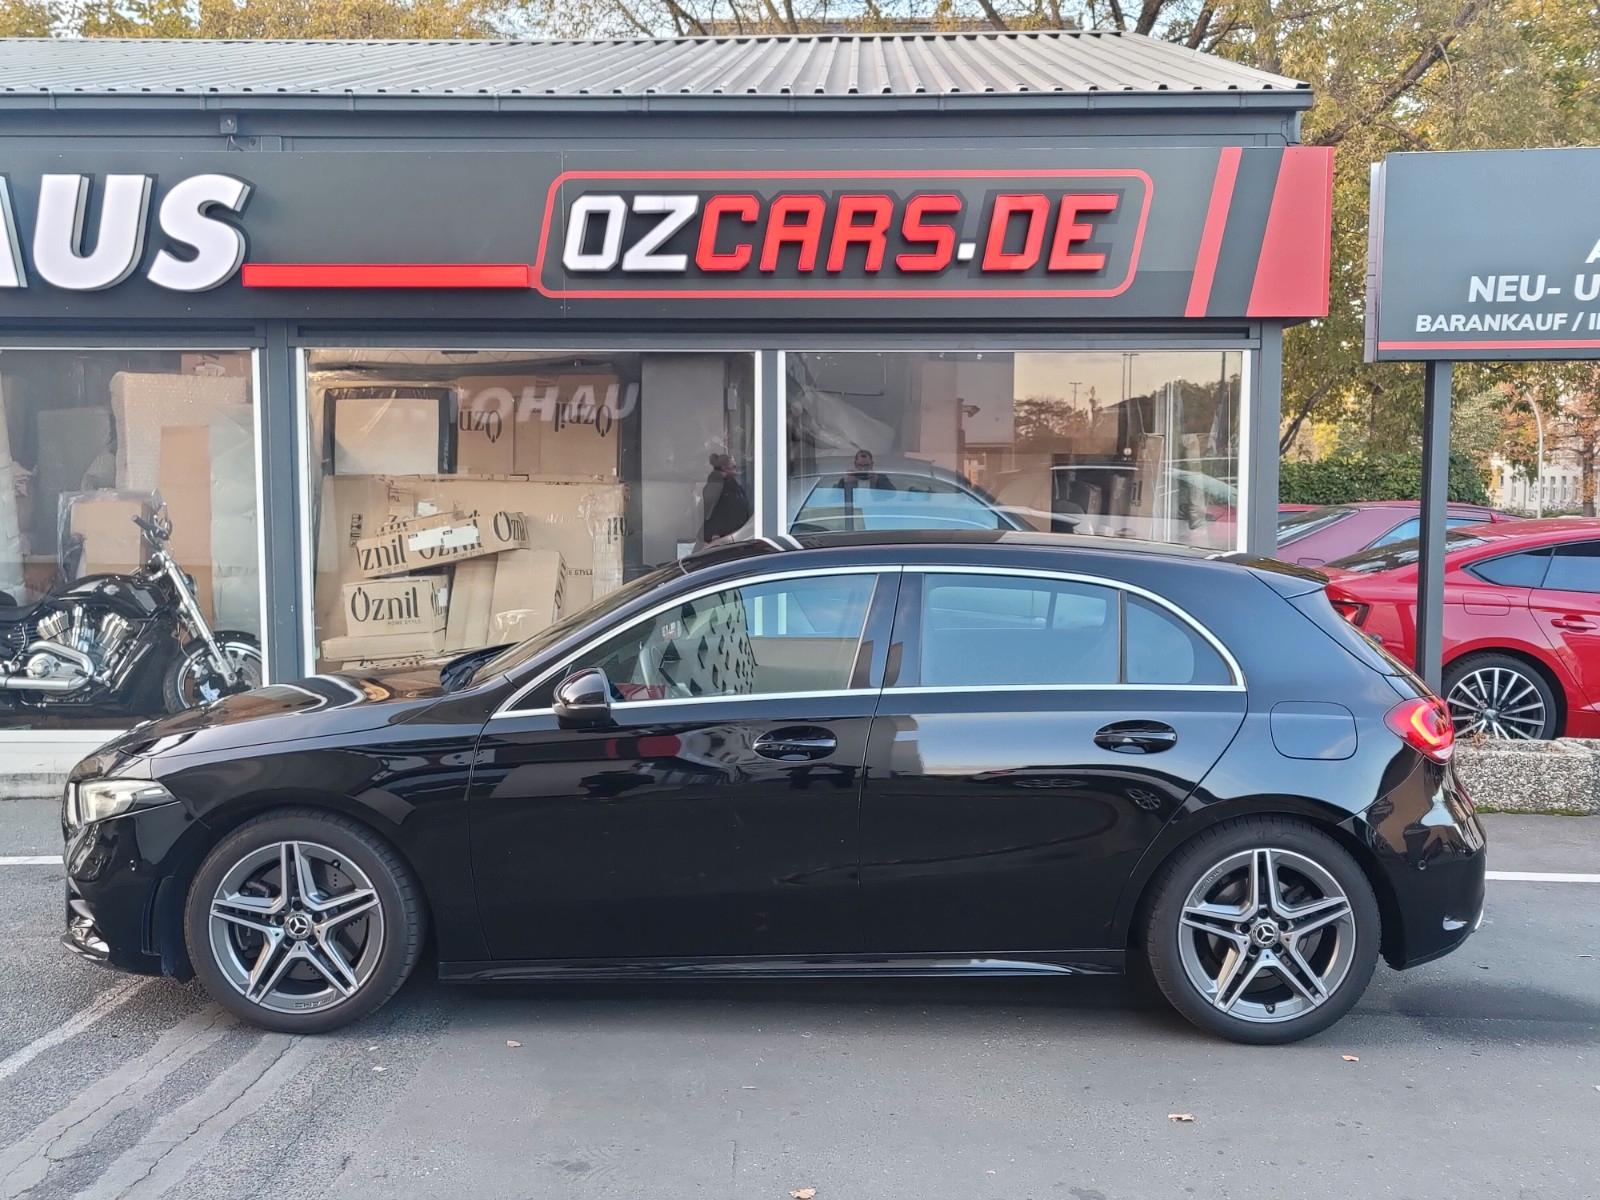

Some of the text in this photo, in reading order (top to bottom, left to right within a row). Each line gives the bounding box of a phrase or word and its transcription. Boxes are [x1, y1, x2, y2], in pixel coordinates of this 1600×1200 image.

[0, 174, 250, 292] US
[562, 193, 1119, 273] OZCARS.DE
[1468, 275, 1561, 303] NEU-
[1416, 313, 1568, 333] BARANKAUF
[1571, 312, 1585, 332] /
